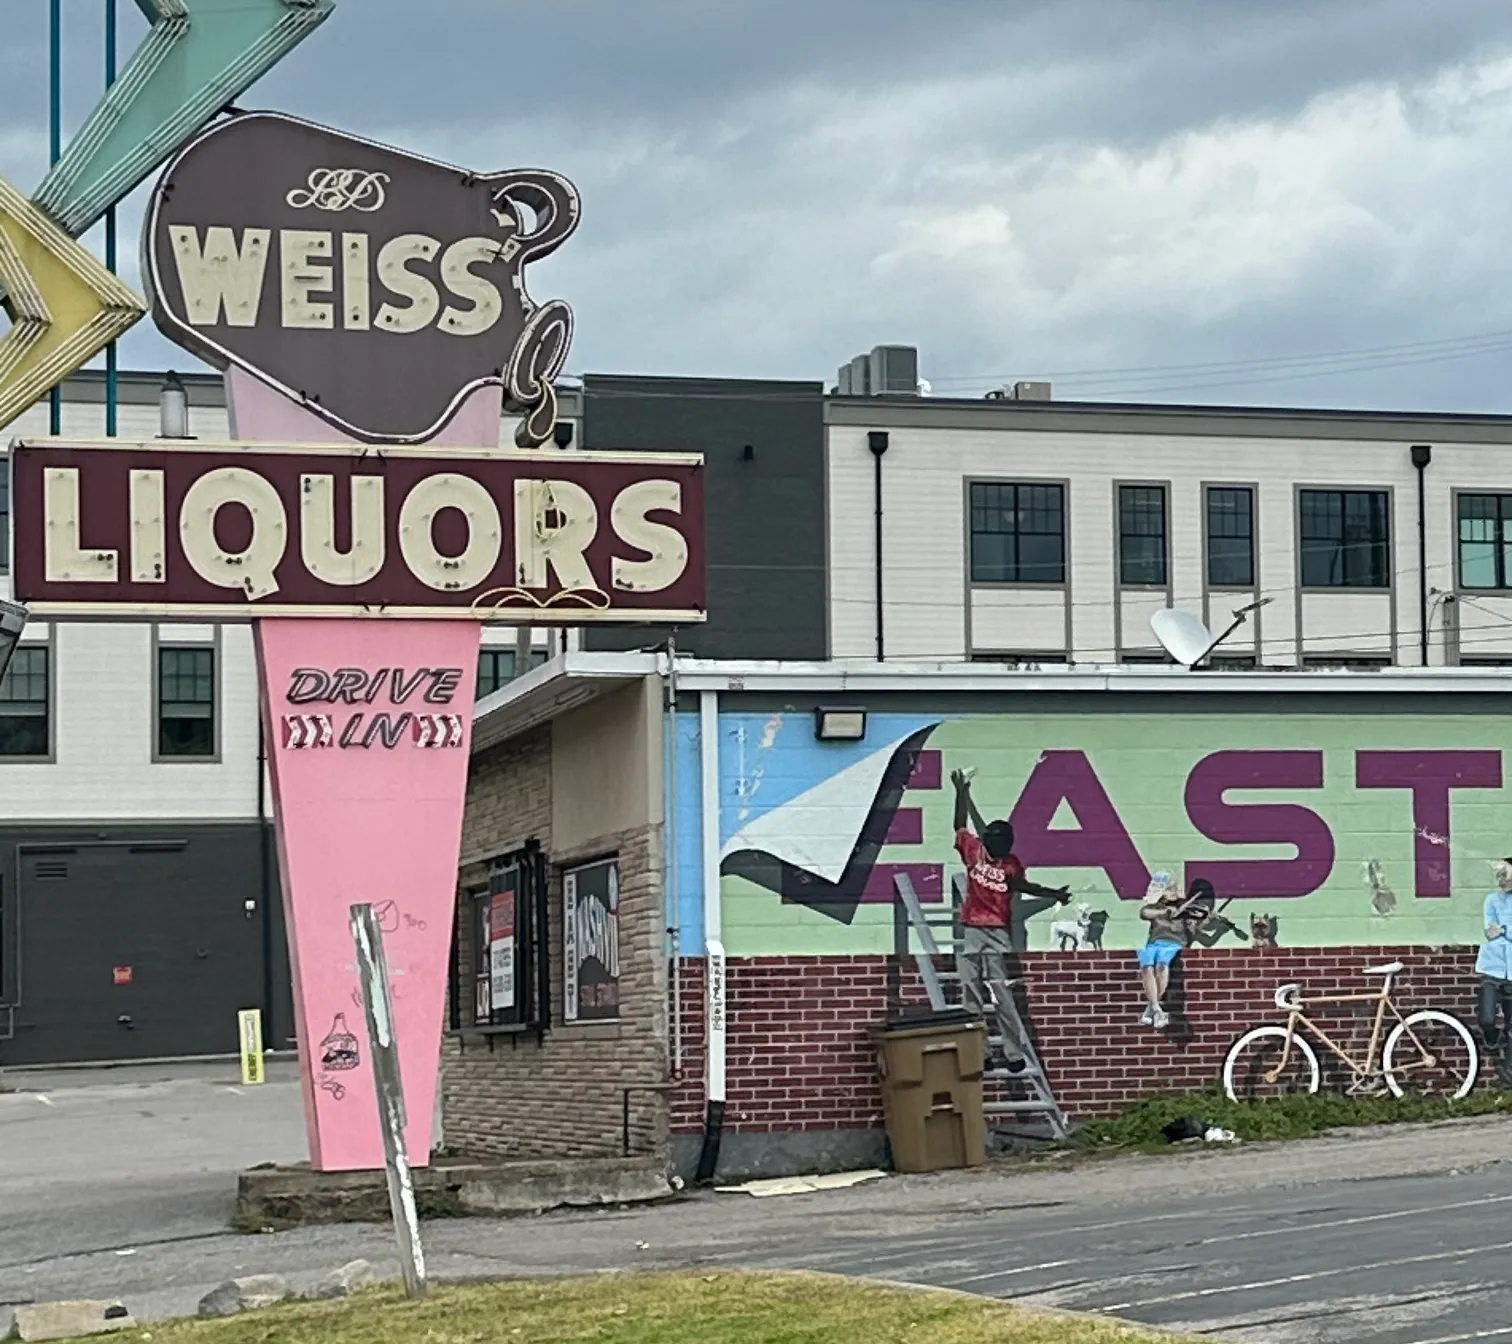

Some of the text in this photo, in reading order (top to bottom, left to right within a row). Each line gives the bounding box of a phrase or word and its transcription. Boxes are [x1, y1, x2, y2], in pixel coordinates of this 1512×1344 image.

[167, 224, 505, 336] WEISS
[42, 466, 690, 601] LIQUORS
[286, 667, 463, 705] DRIVE
[339, 712, 413, 750] IN
